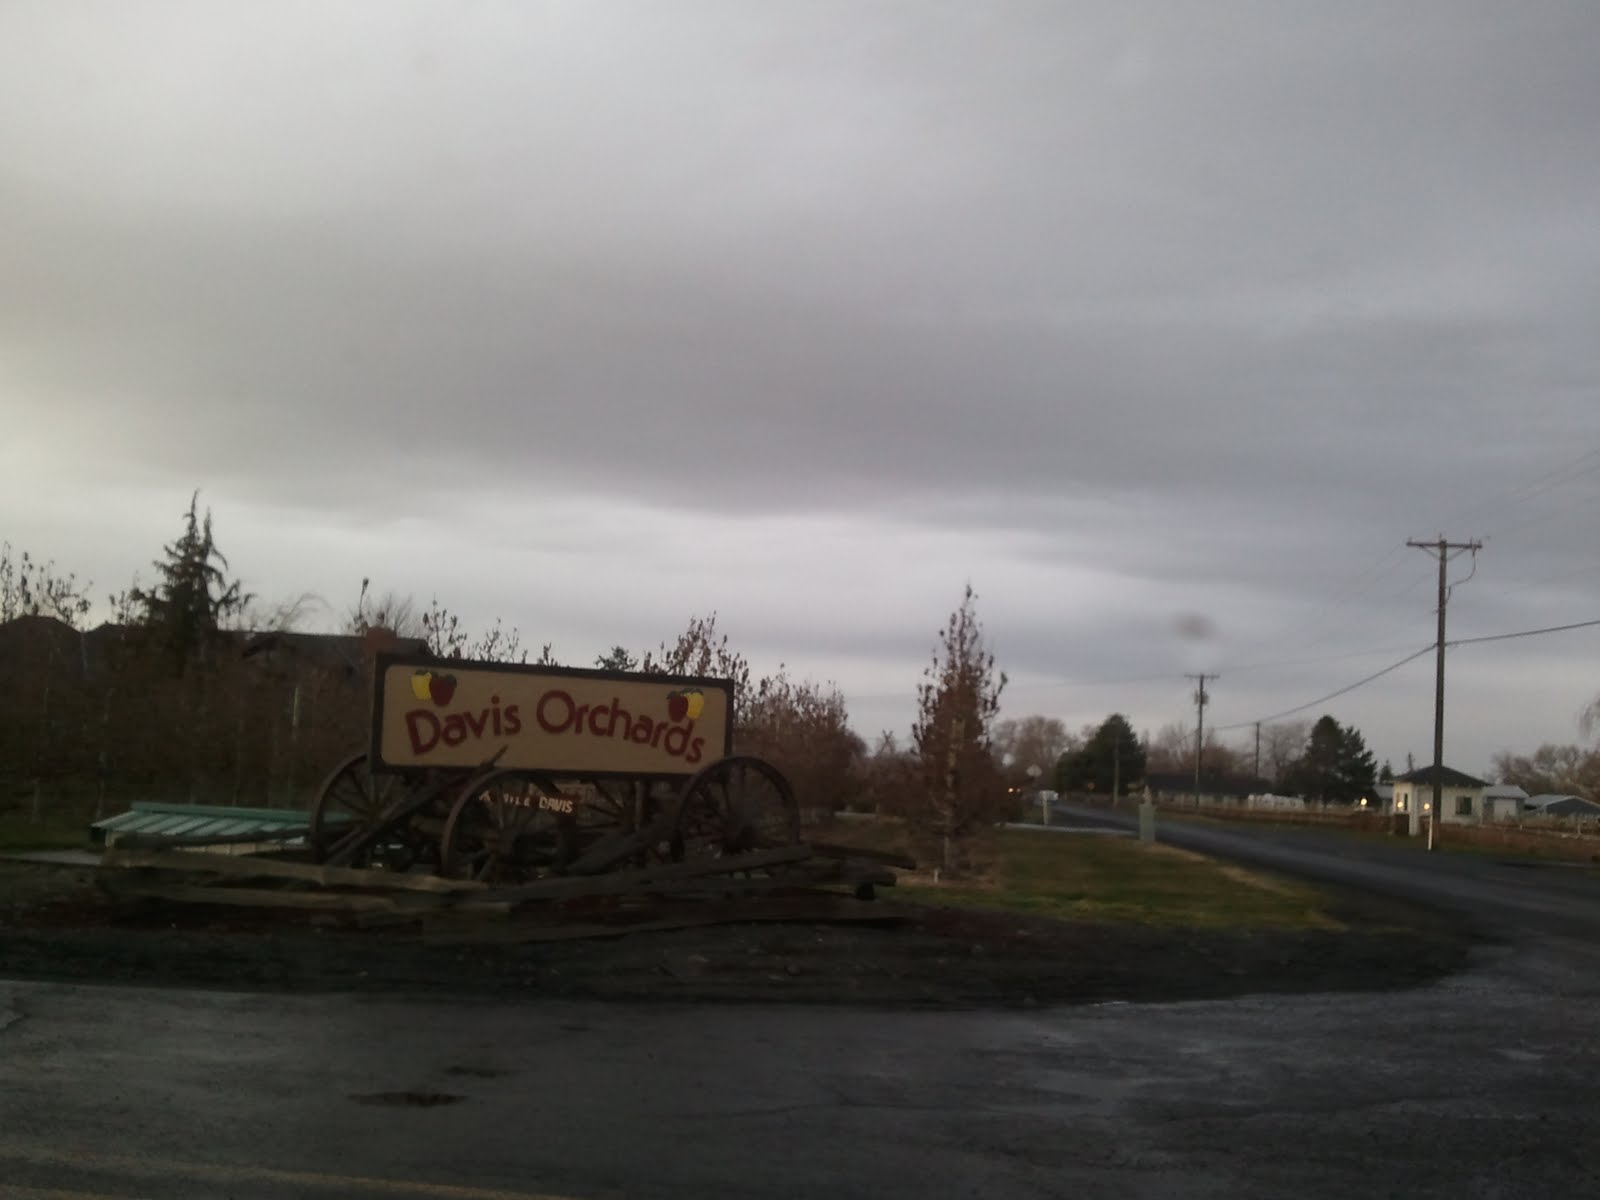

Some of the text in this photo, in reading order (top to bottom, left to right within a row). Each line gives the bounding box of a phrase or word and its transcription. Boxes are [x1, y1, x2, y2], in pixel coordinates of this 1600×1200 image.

[405, 690, 706, 764] Davis Orchards
[538, 795, 574, 814] DAVIS
